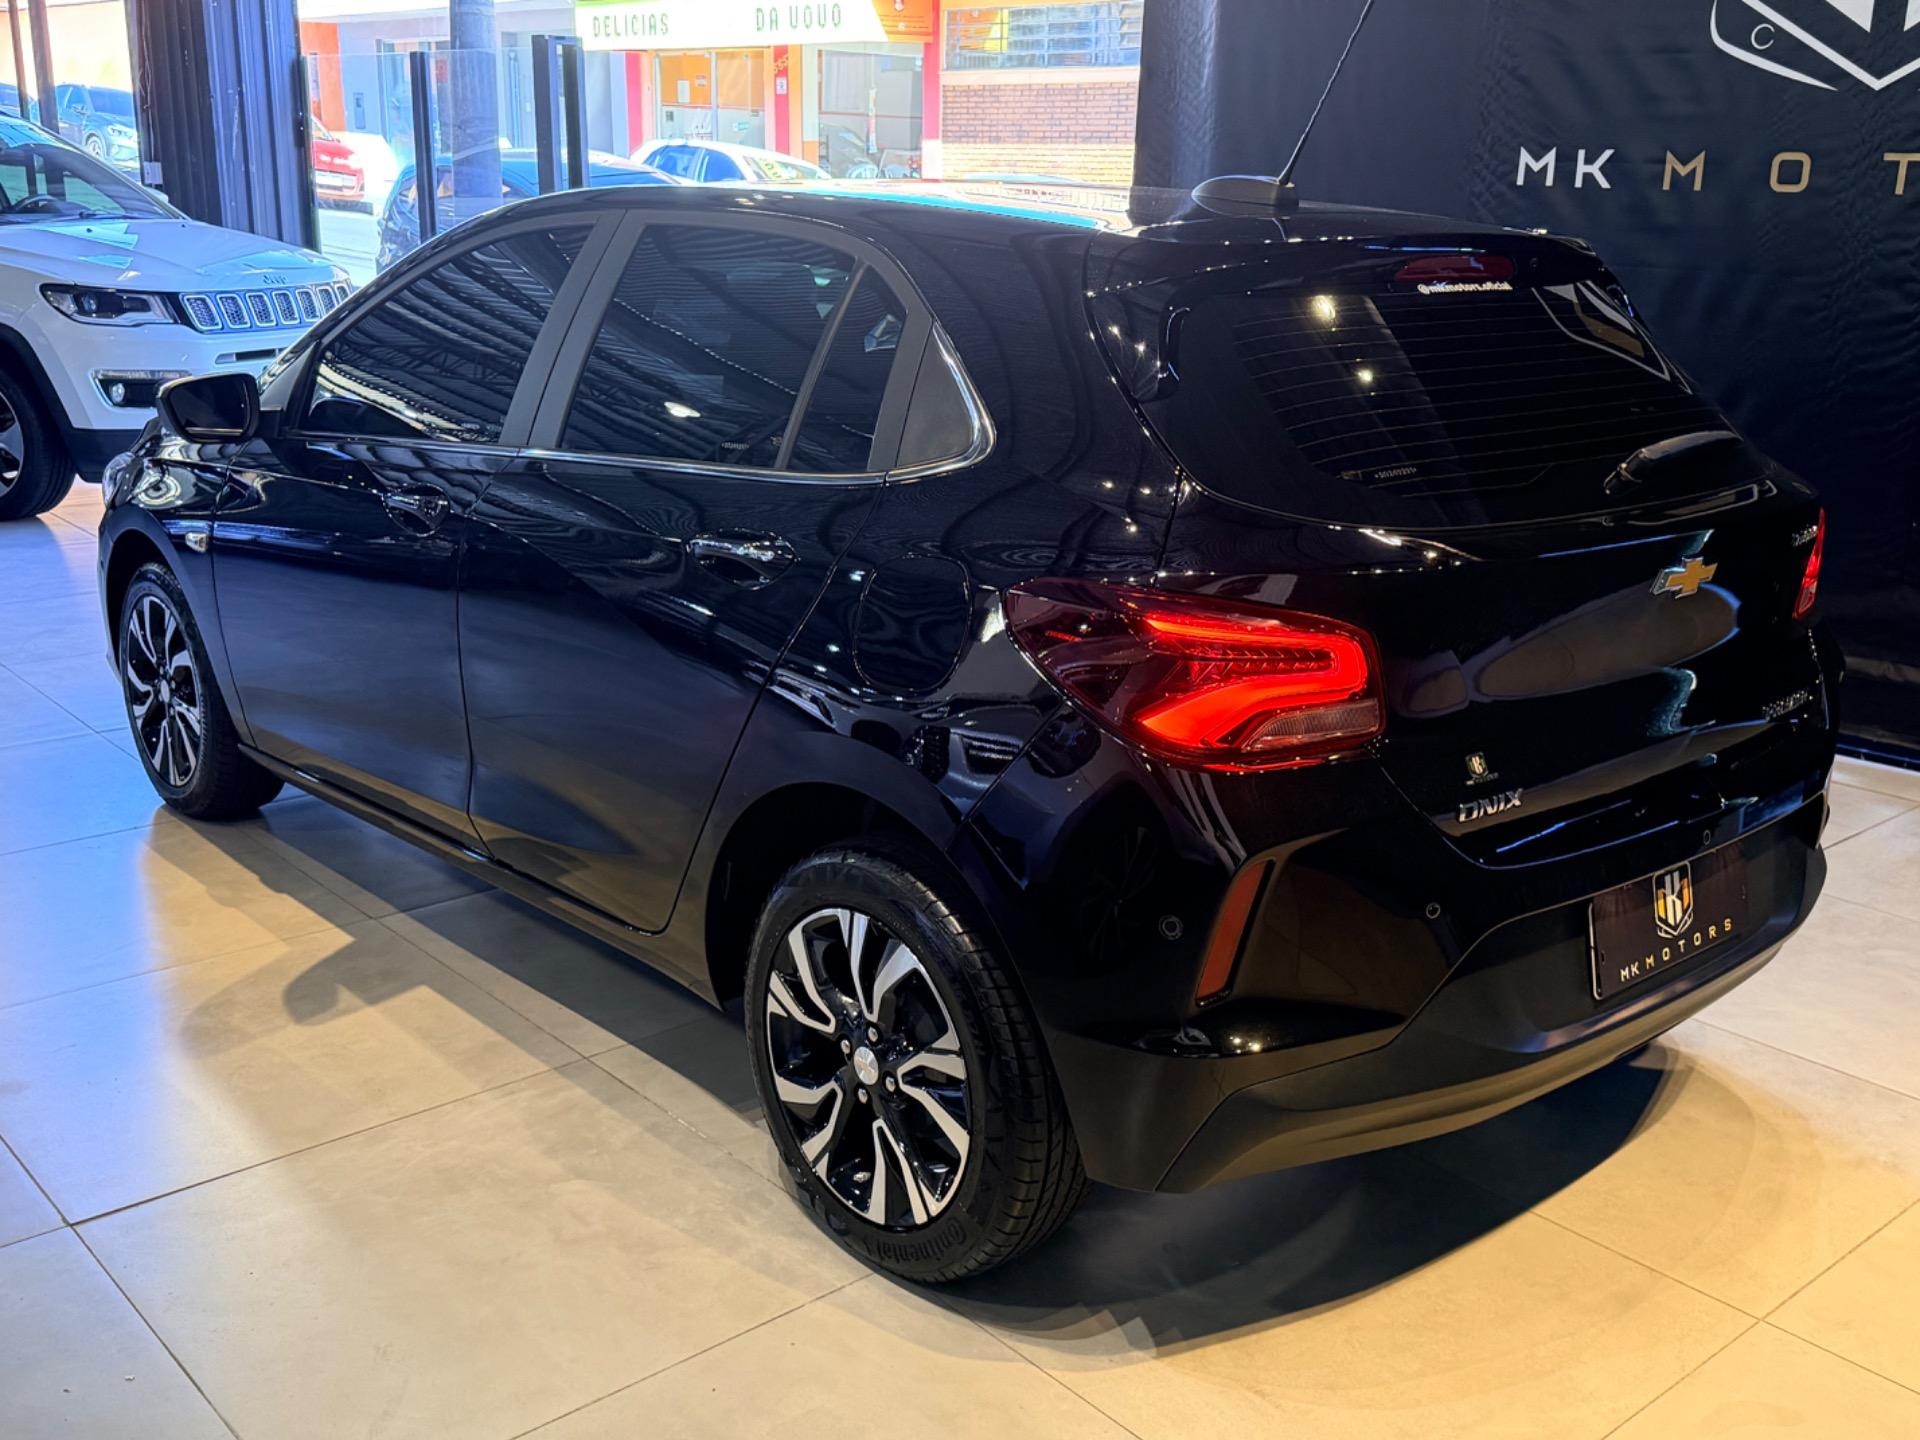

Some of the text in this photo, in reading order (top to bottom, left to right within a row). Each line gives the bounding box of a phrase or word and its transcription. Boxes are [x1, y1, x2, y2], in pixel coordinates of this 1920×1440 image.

[592, 12, 669, 38] DELICIAS
[755, 7, 779, 32] DA
[1516, 146, 1615, 189] MK
[1459, 788, 1523, 822] ONIX
[1620, 918, 1733, 983] MK MOTORS
